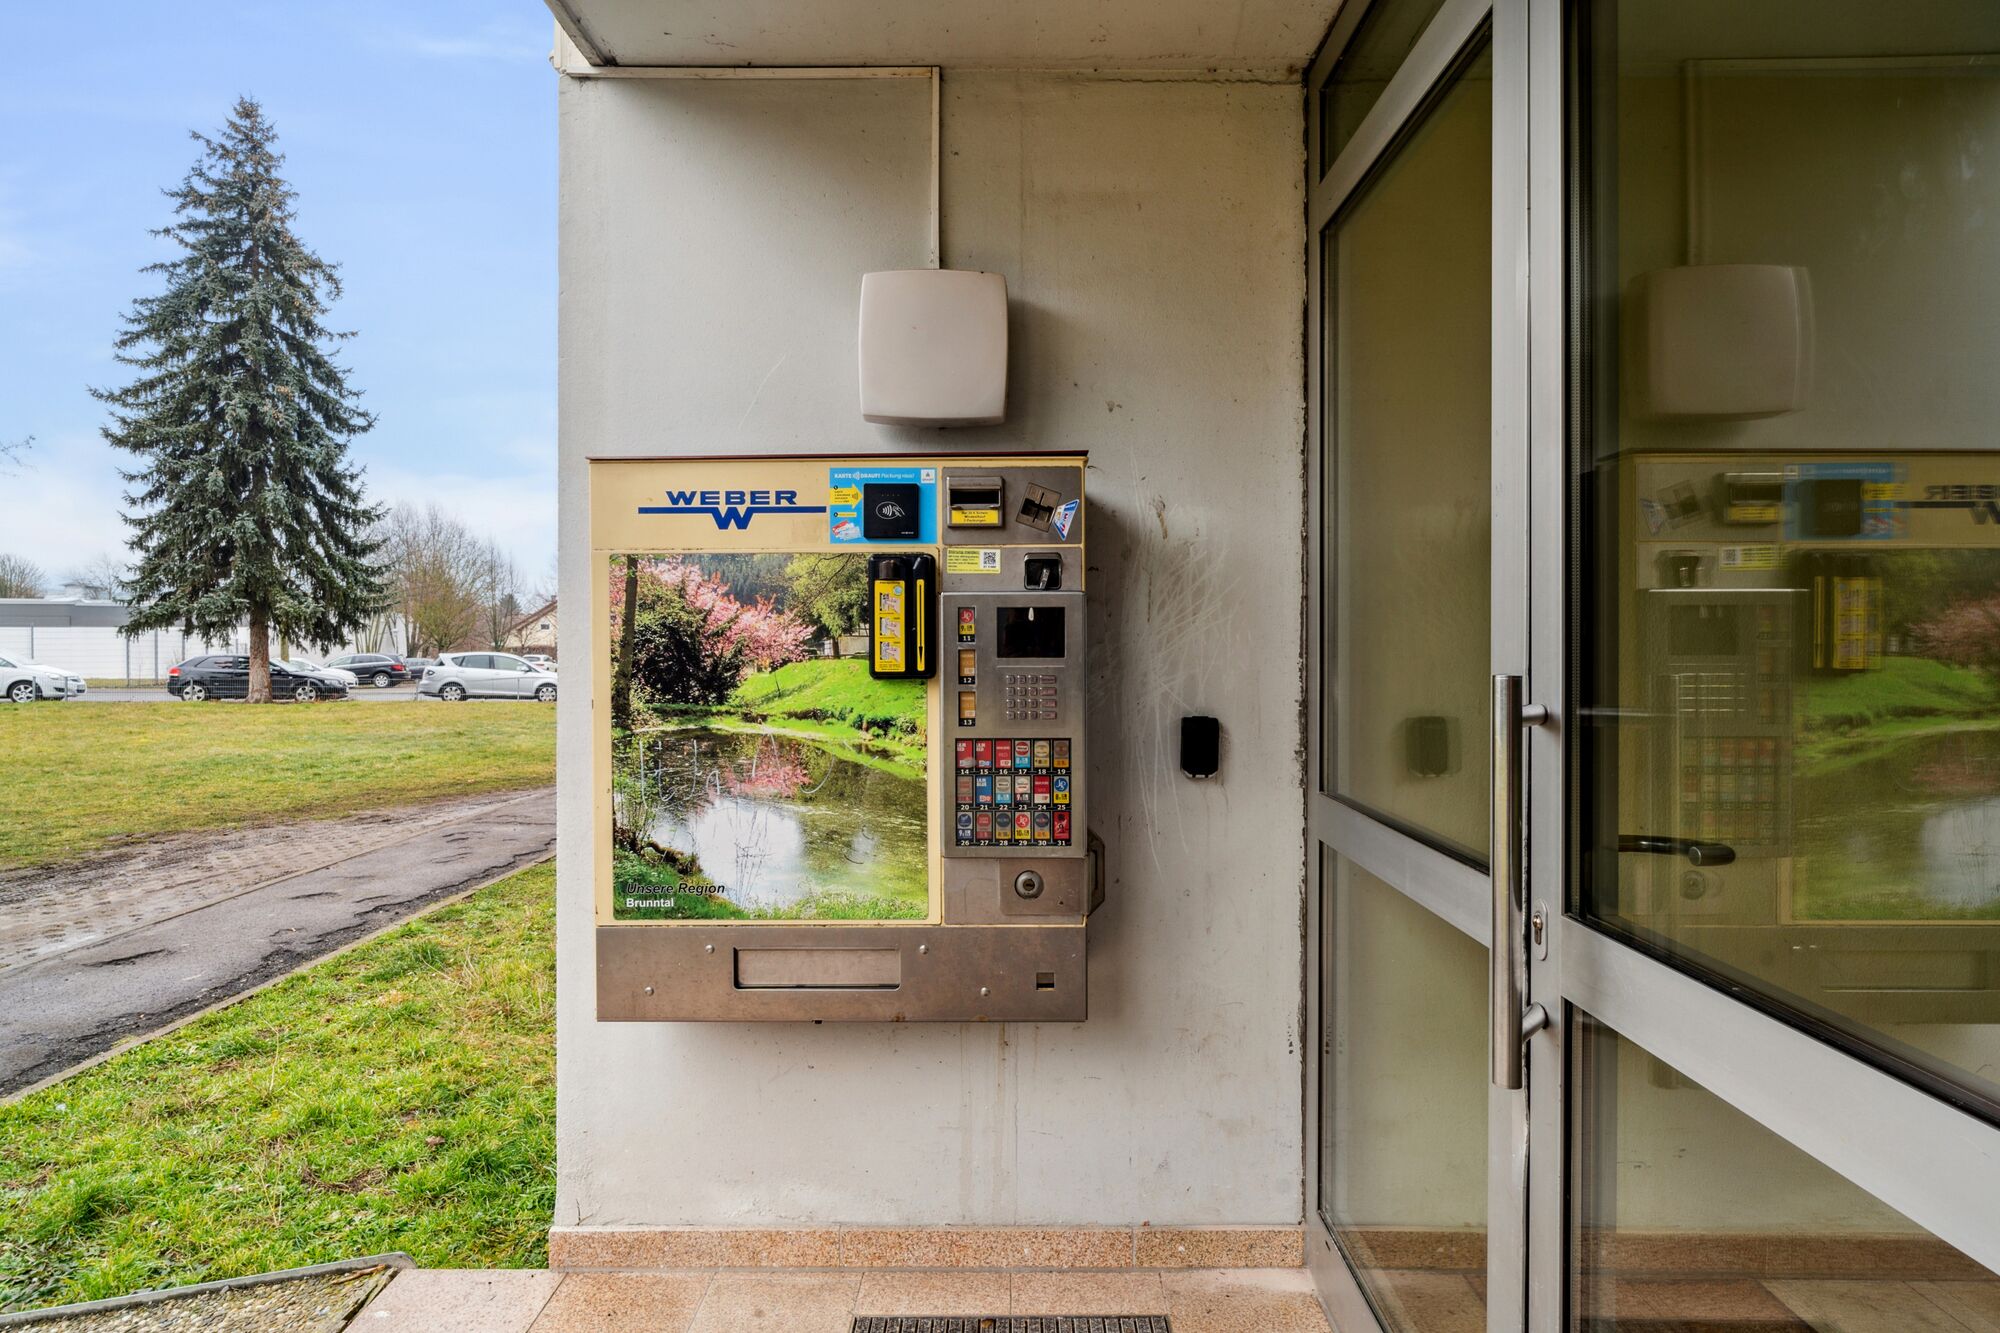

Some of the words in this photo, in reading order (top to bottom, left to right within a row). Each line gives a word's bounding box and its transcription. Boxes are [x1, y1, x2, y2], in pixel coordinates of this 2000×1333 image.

[665, 490, 798, 506] WEBER
[626, 882, 674, 895] Unsere
[678, 882, 726, 897] Region
[626, 898, 675, 908] Brunntal
